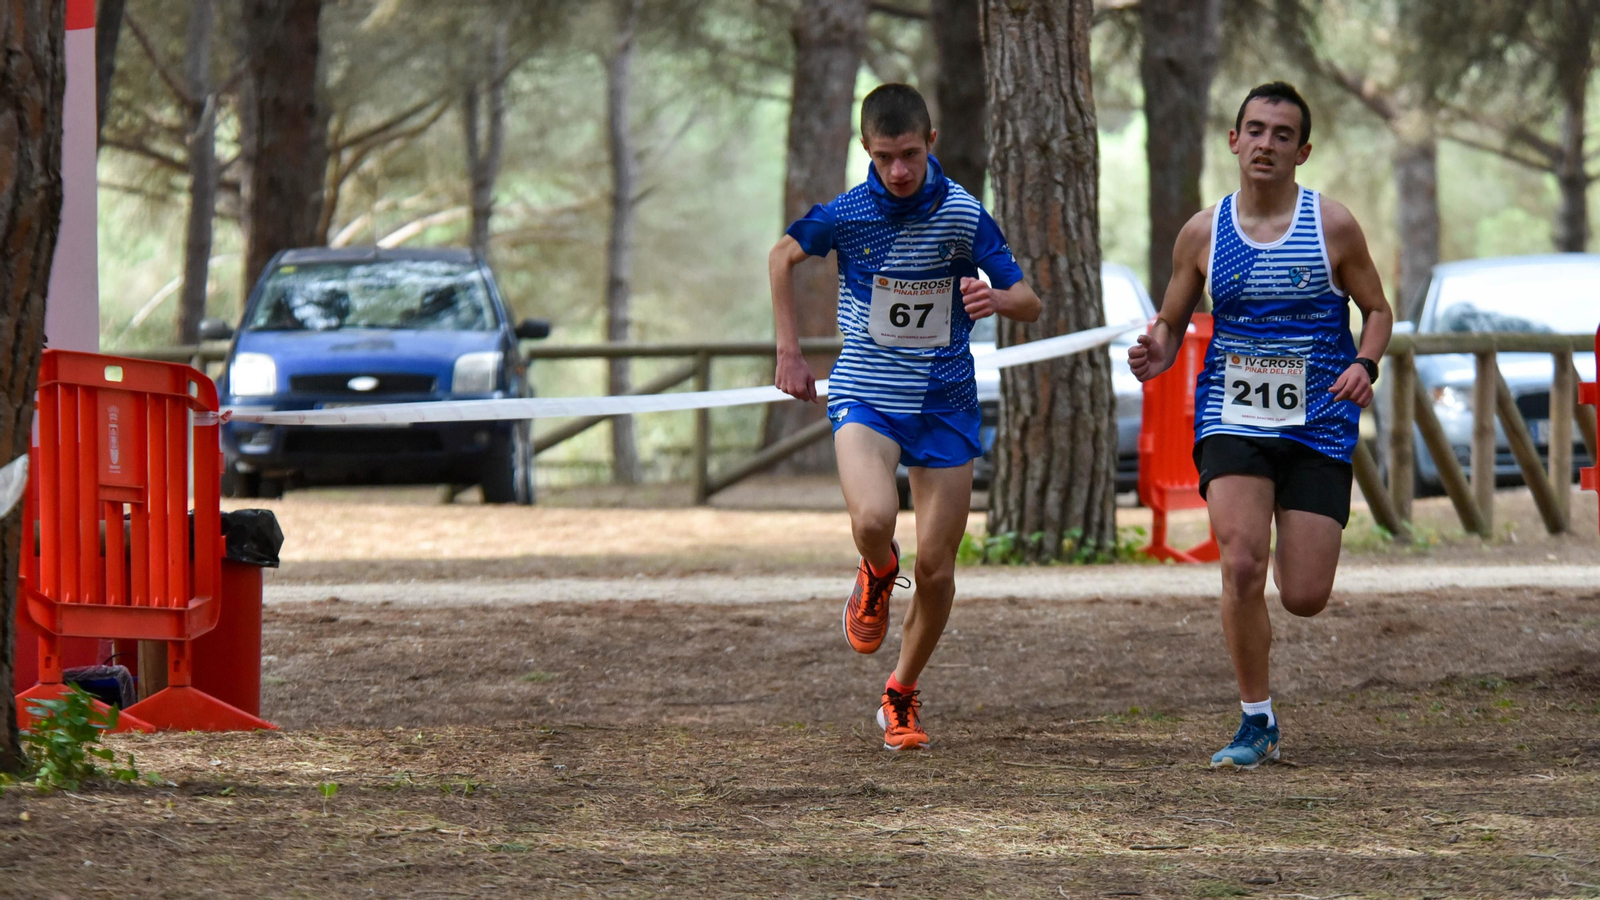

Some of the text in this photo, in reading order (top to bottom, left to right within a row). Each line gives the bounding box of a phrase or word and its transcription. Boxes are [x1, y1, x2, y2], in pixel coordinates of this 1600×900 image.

[893, 288, 919, 296] PINAR
[889, 302, 934, 329] 67
[1244, 366, 1268, 374] PINAR
[1231, 379, 1299, 410] 216
